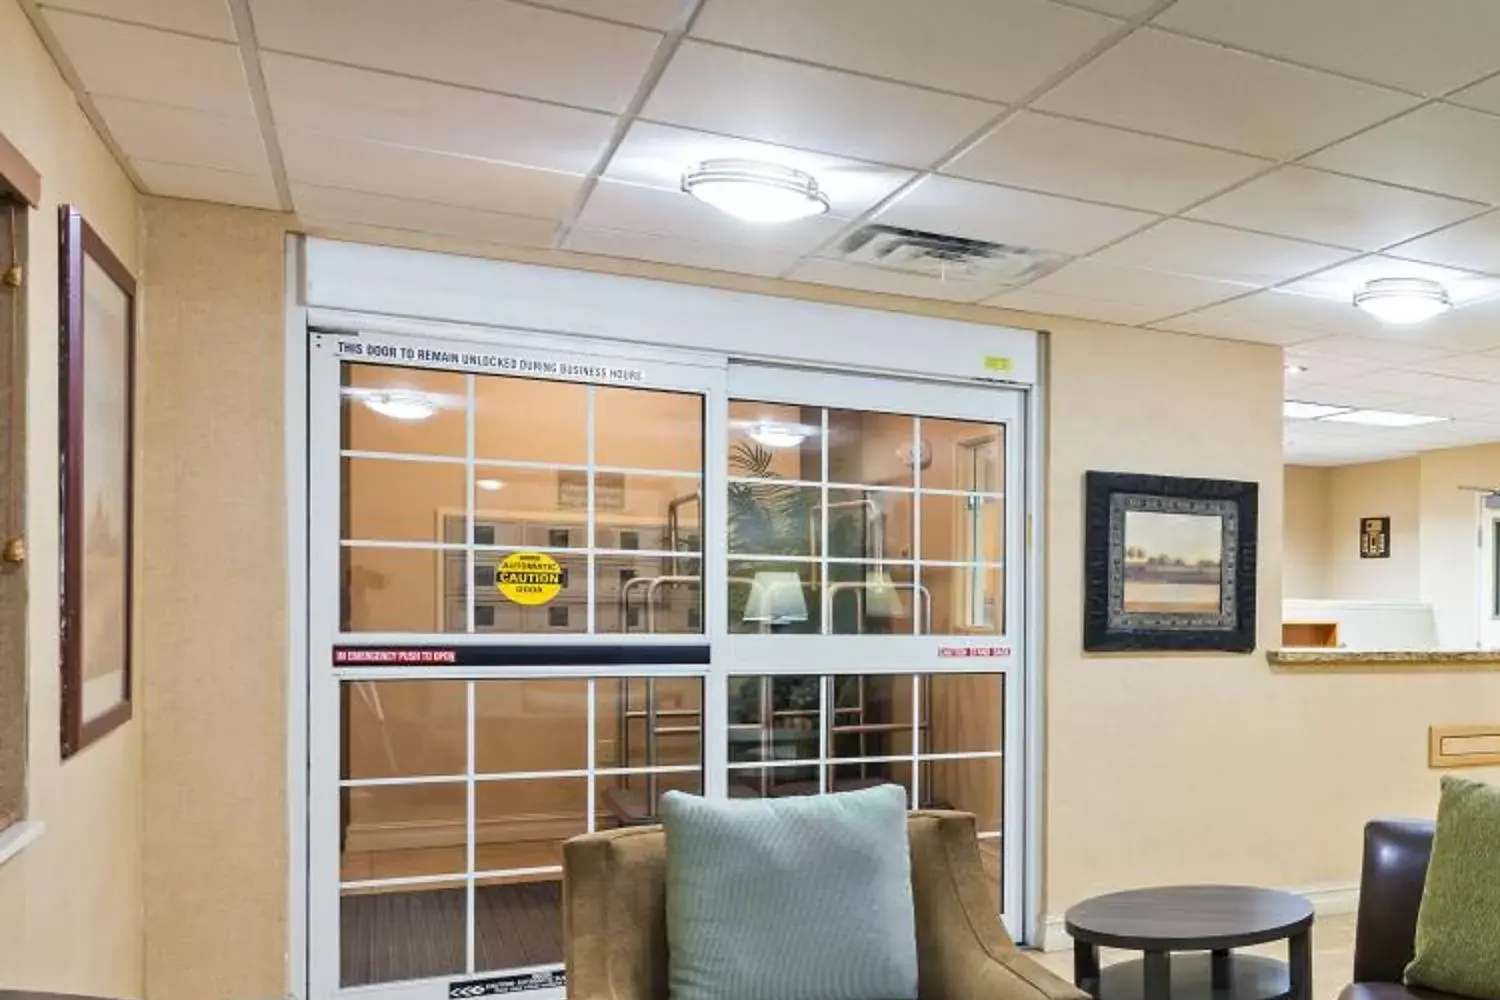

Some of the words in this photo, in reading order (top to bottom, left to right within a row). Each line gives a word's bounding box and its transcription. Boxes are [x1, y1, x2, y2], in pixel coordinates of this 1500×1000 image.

[338, 341, 363, 355] THIS
[366, 343, 397, 359] DOOR
[400, 347, 415, 359] TO
[418, 349, 459, 364] REMAIN
[461, 352, 517, 369] UNLOCKED
[519, 358, 557, 373] DURING
[559, 362, 607, 378] BUSINESS
[609, 367, 642, 381] HOURS
[502, 562, 558, 570] AUTOMATIC
[499, 573, 560, 583] CAUTION
[348, 651, 397, 661] EMERGENCY
[398, 651, 420, 661] PUSH
[421, 651, 433, 661] TO
[433, 651, 456, 662] OPEN
